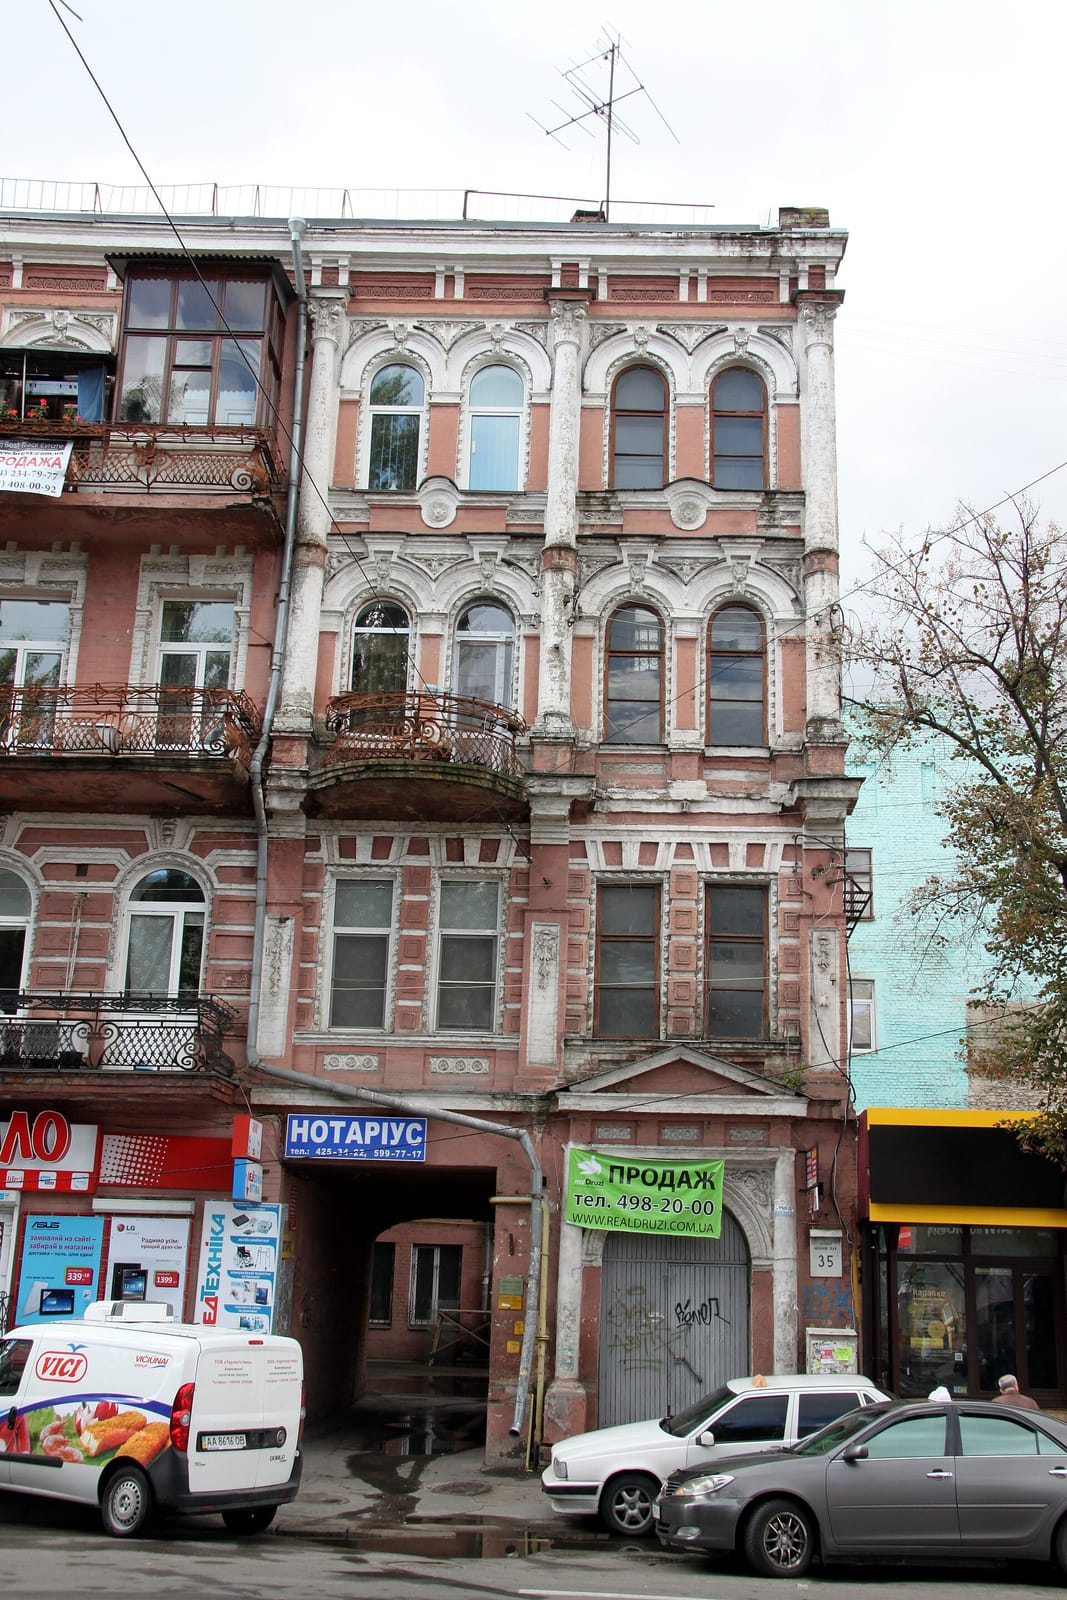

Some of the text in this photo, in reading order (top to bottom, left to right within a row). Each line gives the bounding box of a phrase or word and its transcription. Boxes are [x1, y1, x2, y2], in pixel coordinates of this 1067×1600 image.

[8, 481, 57, 493] 408-00-92
[290, 1119, 423, 1146] НОТАРІУС
[373, 1149, 422, 1158] 599-77-17
[608, 1165, 716, 1192] ПРОДАЖ
[574, 1194, 714, 1216] тел. 498-20-00
[32, 1221, 61, 1229] ASUS
[572, 1212, 714, 1234] WWW.REALDRUZI.COM.UA
[199, 1213, 226, 1325] ЕДТЕХНІКА
[818, 1255, 834, 1267] 35
[156, 1276, 173, 1284] 1399
[41, 1357, 83, 1377] VICI
[207, 1437, 217, 1446] AA
